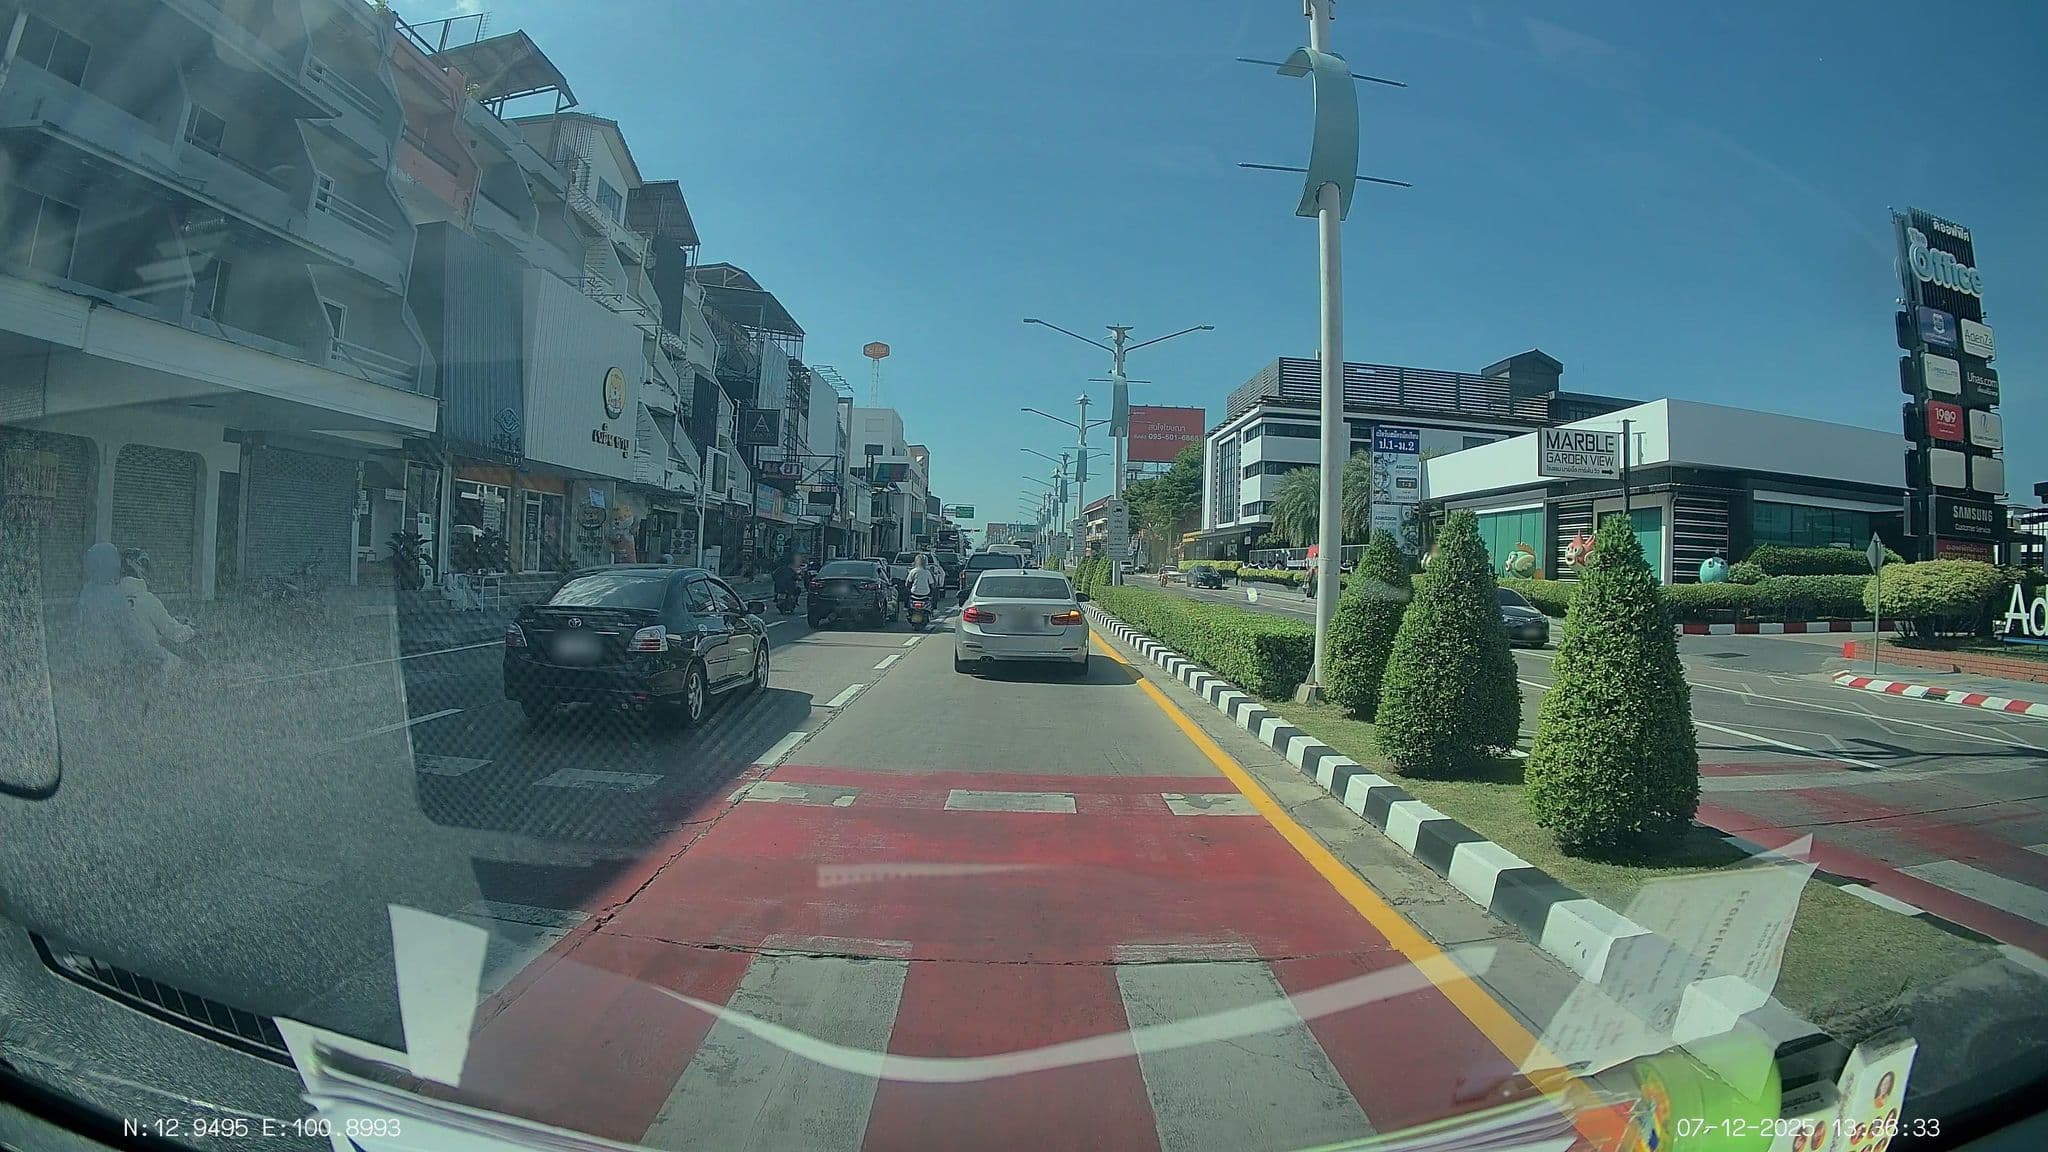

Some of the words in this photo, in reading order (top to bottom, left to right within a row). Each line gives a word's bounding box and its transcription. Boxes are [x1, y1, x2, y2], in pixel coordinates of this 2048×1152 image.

[1909, 242, 1984, 297] Office
[1546, 430, 1615, 453] MARBLE
[1546, 452, 1588, 466] GARDEN
[1589, 456, 1615, 467] VIEW
[1953, 505, 1993, 522] SAMSUNG
